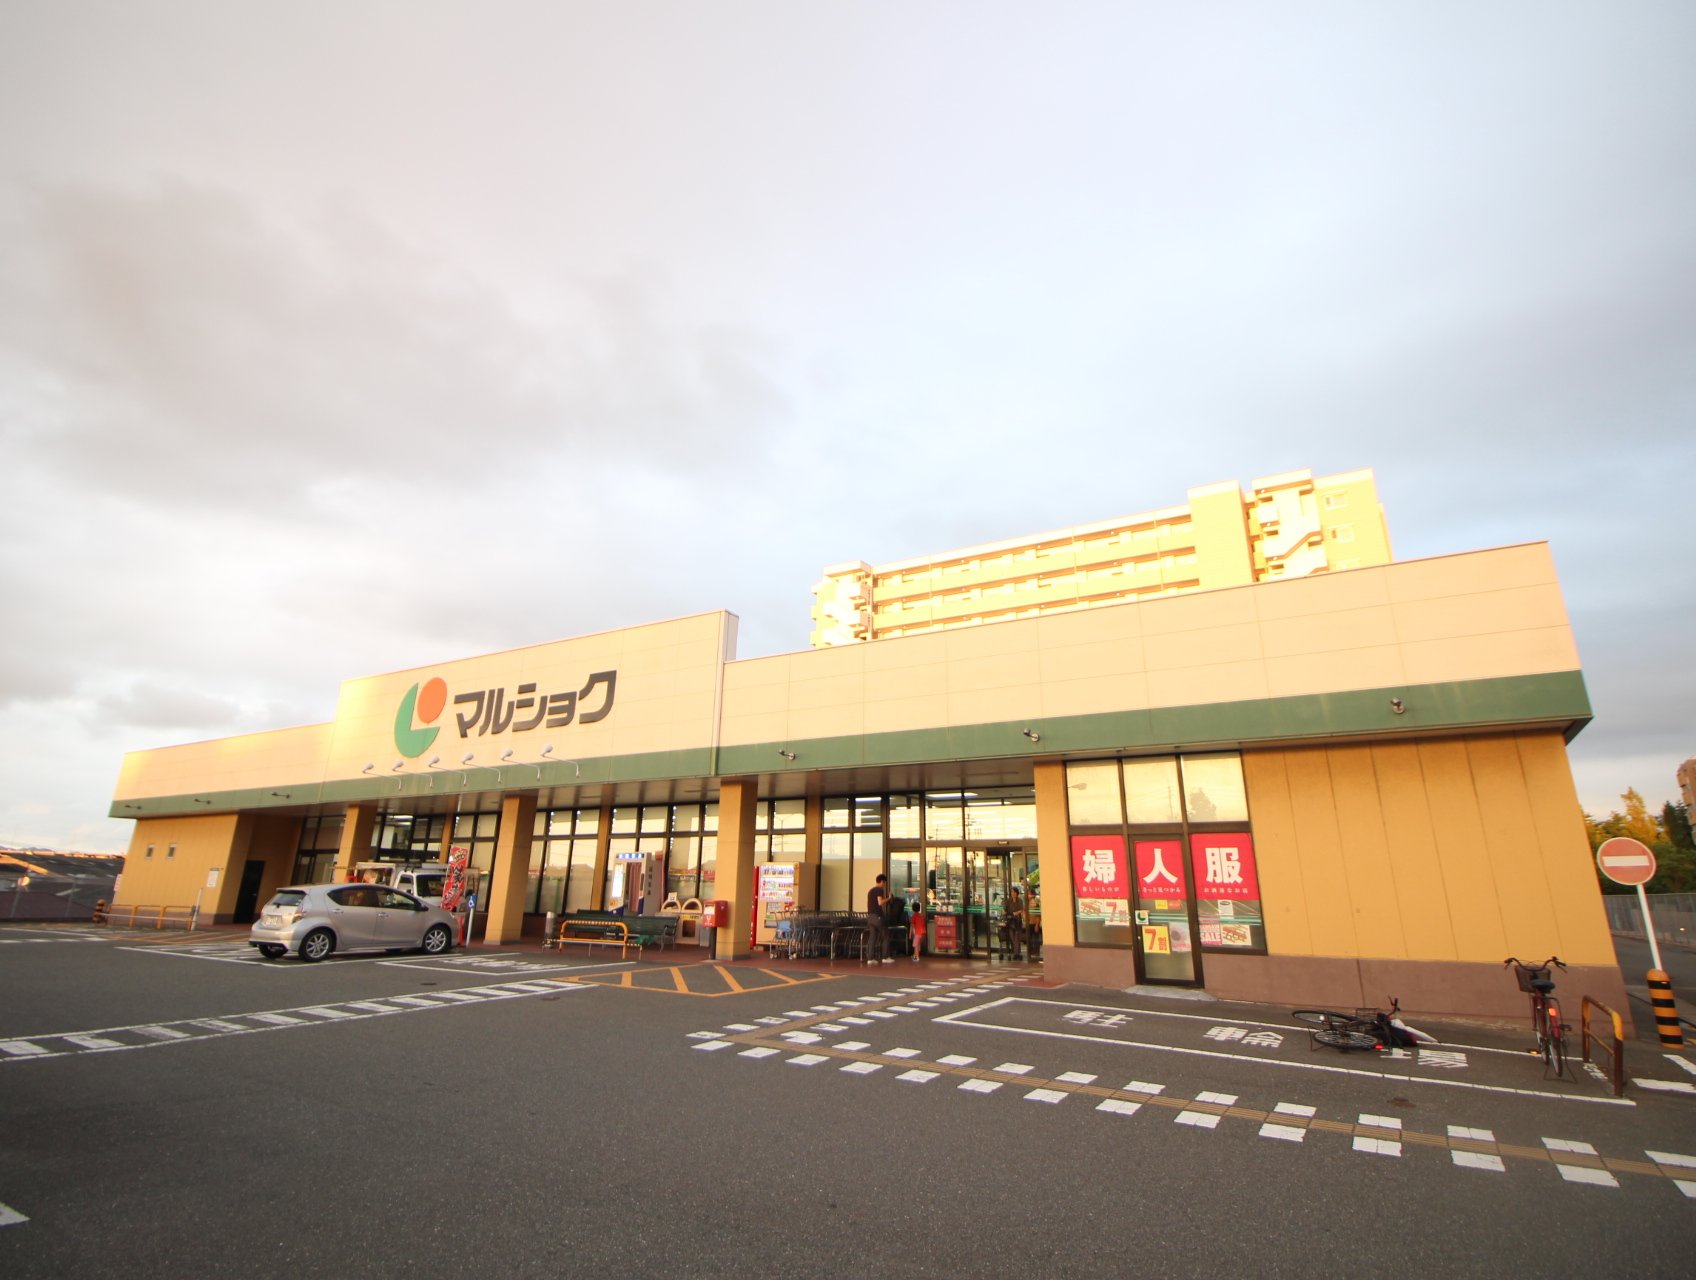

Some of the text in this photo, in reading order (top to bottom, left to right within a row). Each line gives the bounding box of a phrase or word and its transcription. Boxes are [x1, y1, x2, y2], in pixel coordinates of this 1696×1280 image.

[454, 670, 617, 738] マルショク
[1082, 848, 1243, 884] 婦人服
[1200, 932, 1221, 943] SALE
